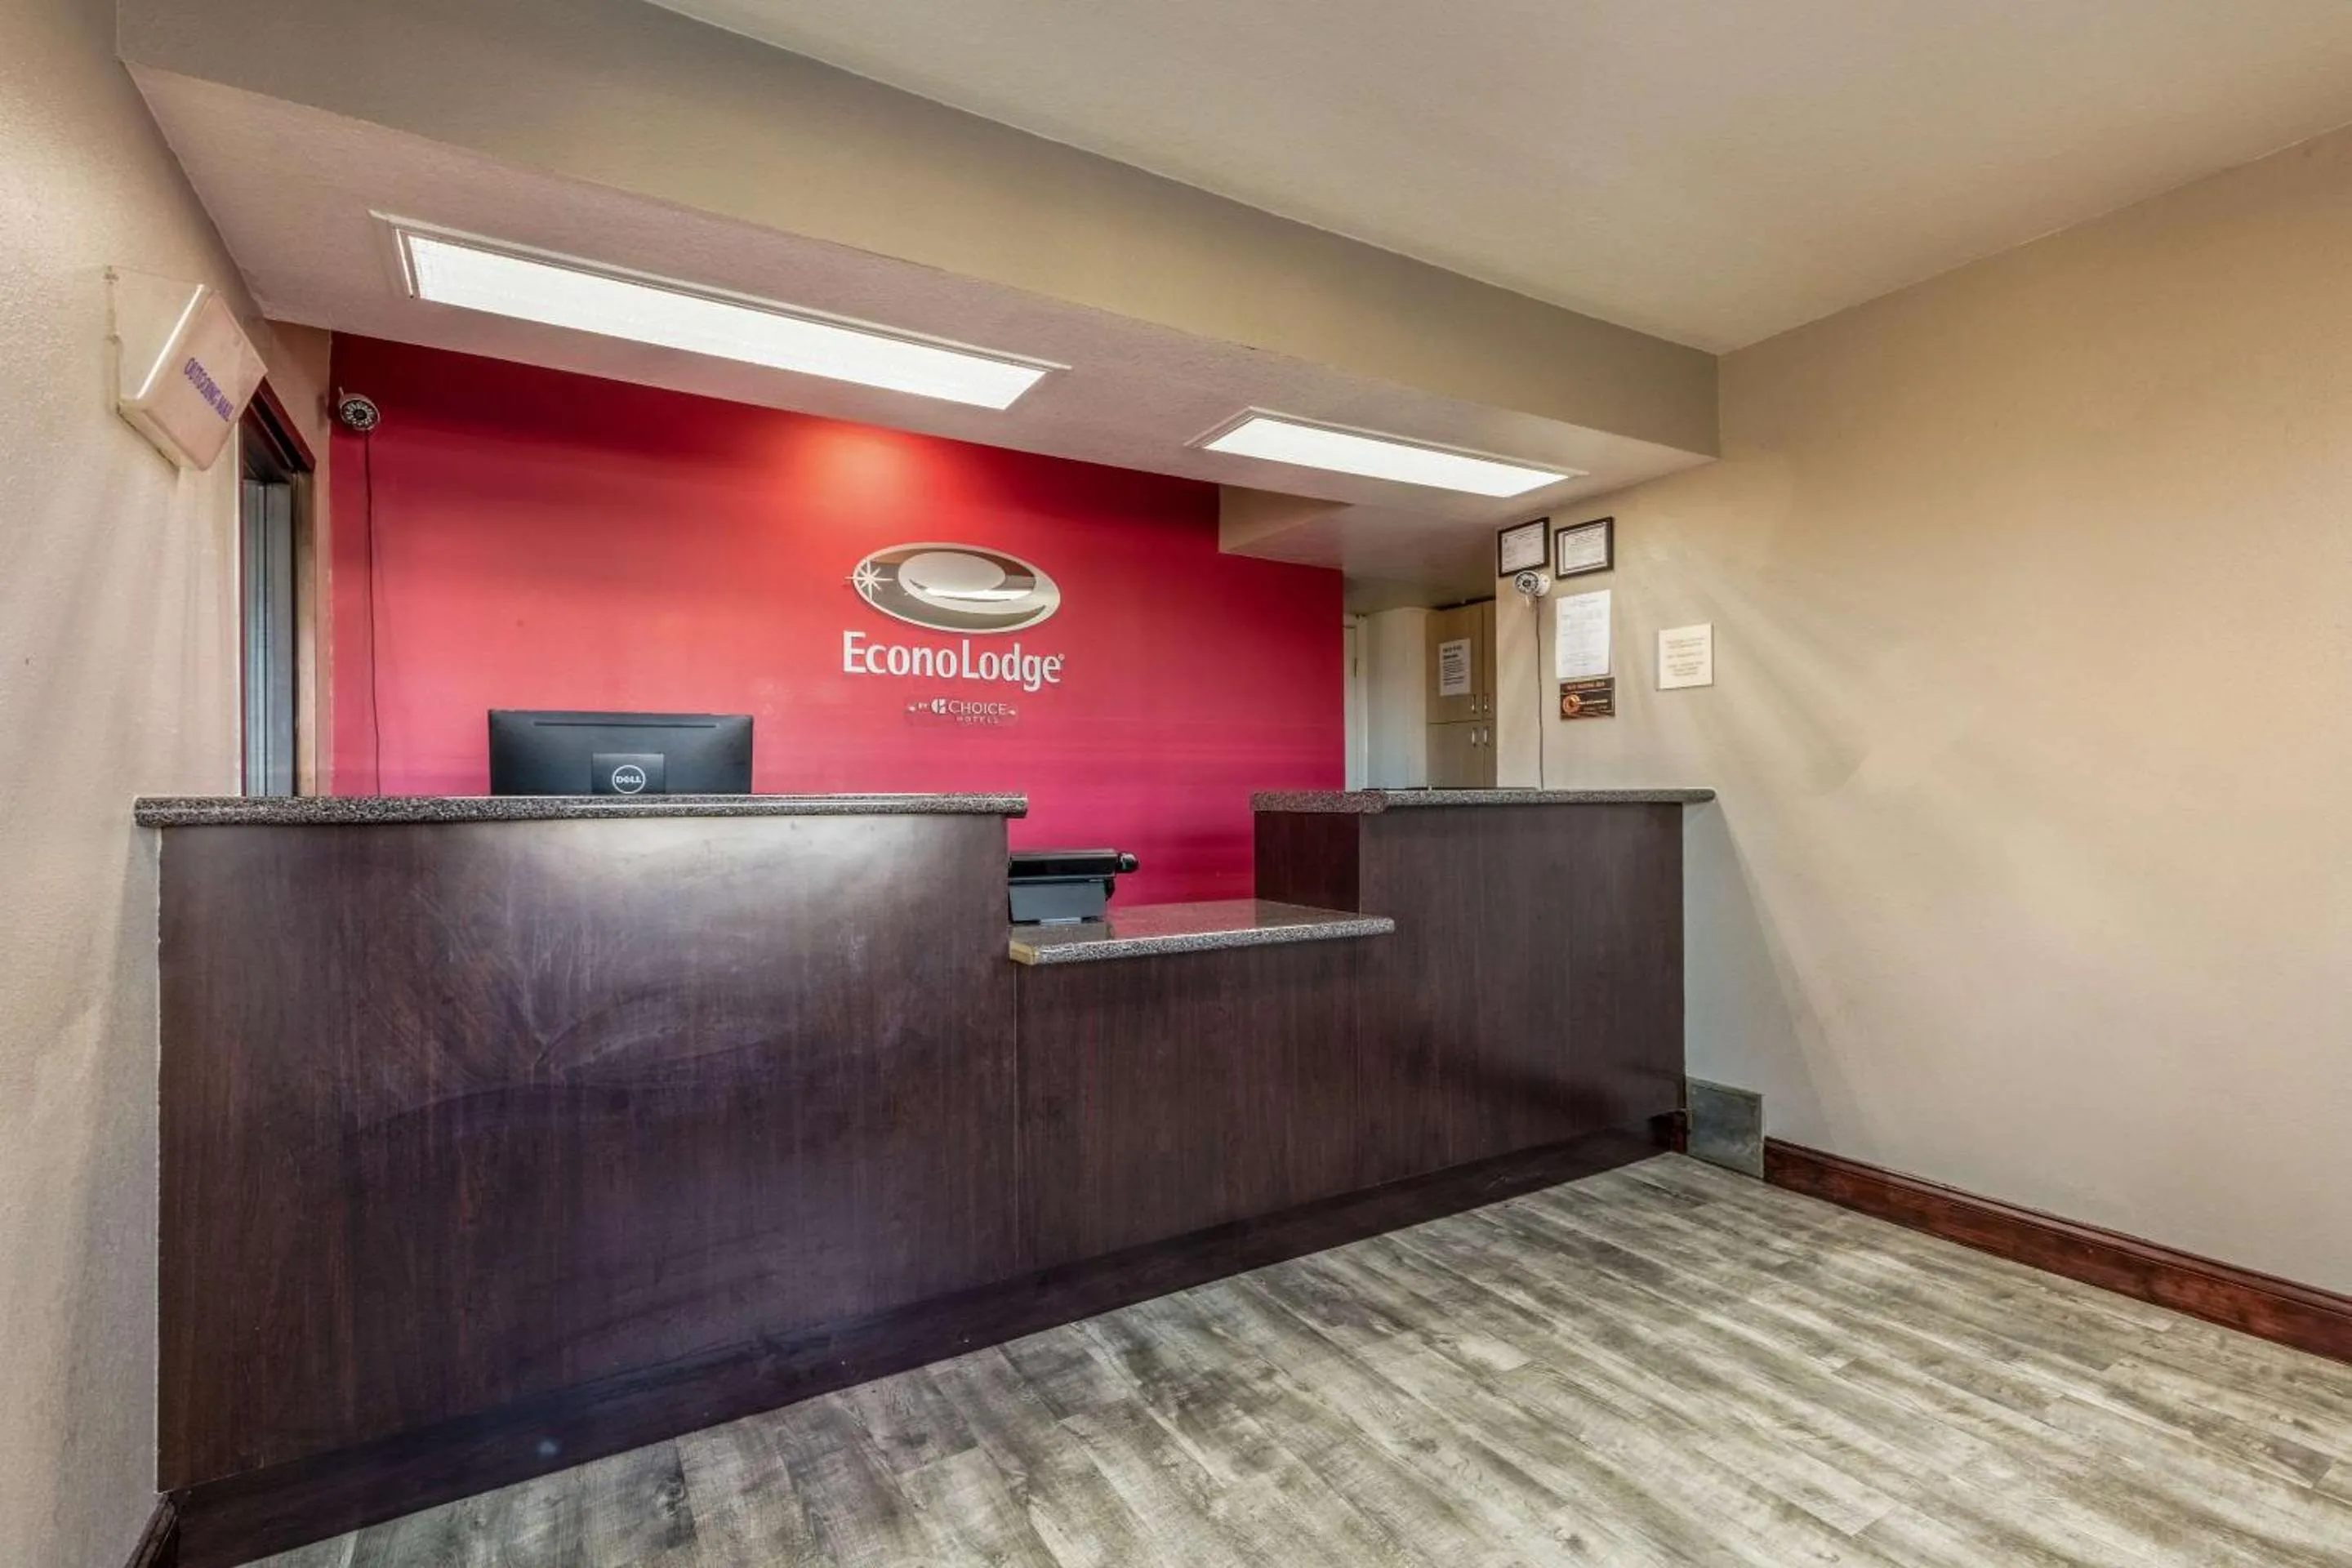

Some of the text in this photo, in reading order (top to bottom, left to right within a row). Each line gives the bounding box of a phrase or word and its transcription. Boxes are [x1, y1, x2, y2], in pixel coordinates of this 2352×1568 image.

[842, 630, 1062, 692] EconoLodge
[948, 700, 1007, 715] CHOICE
[616, 775, 642, 783] DELL
